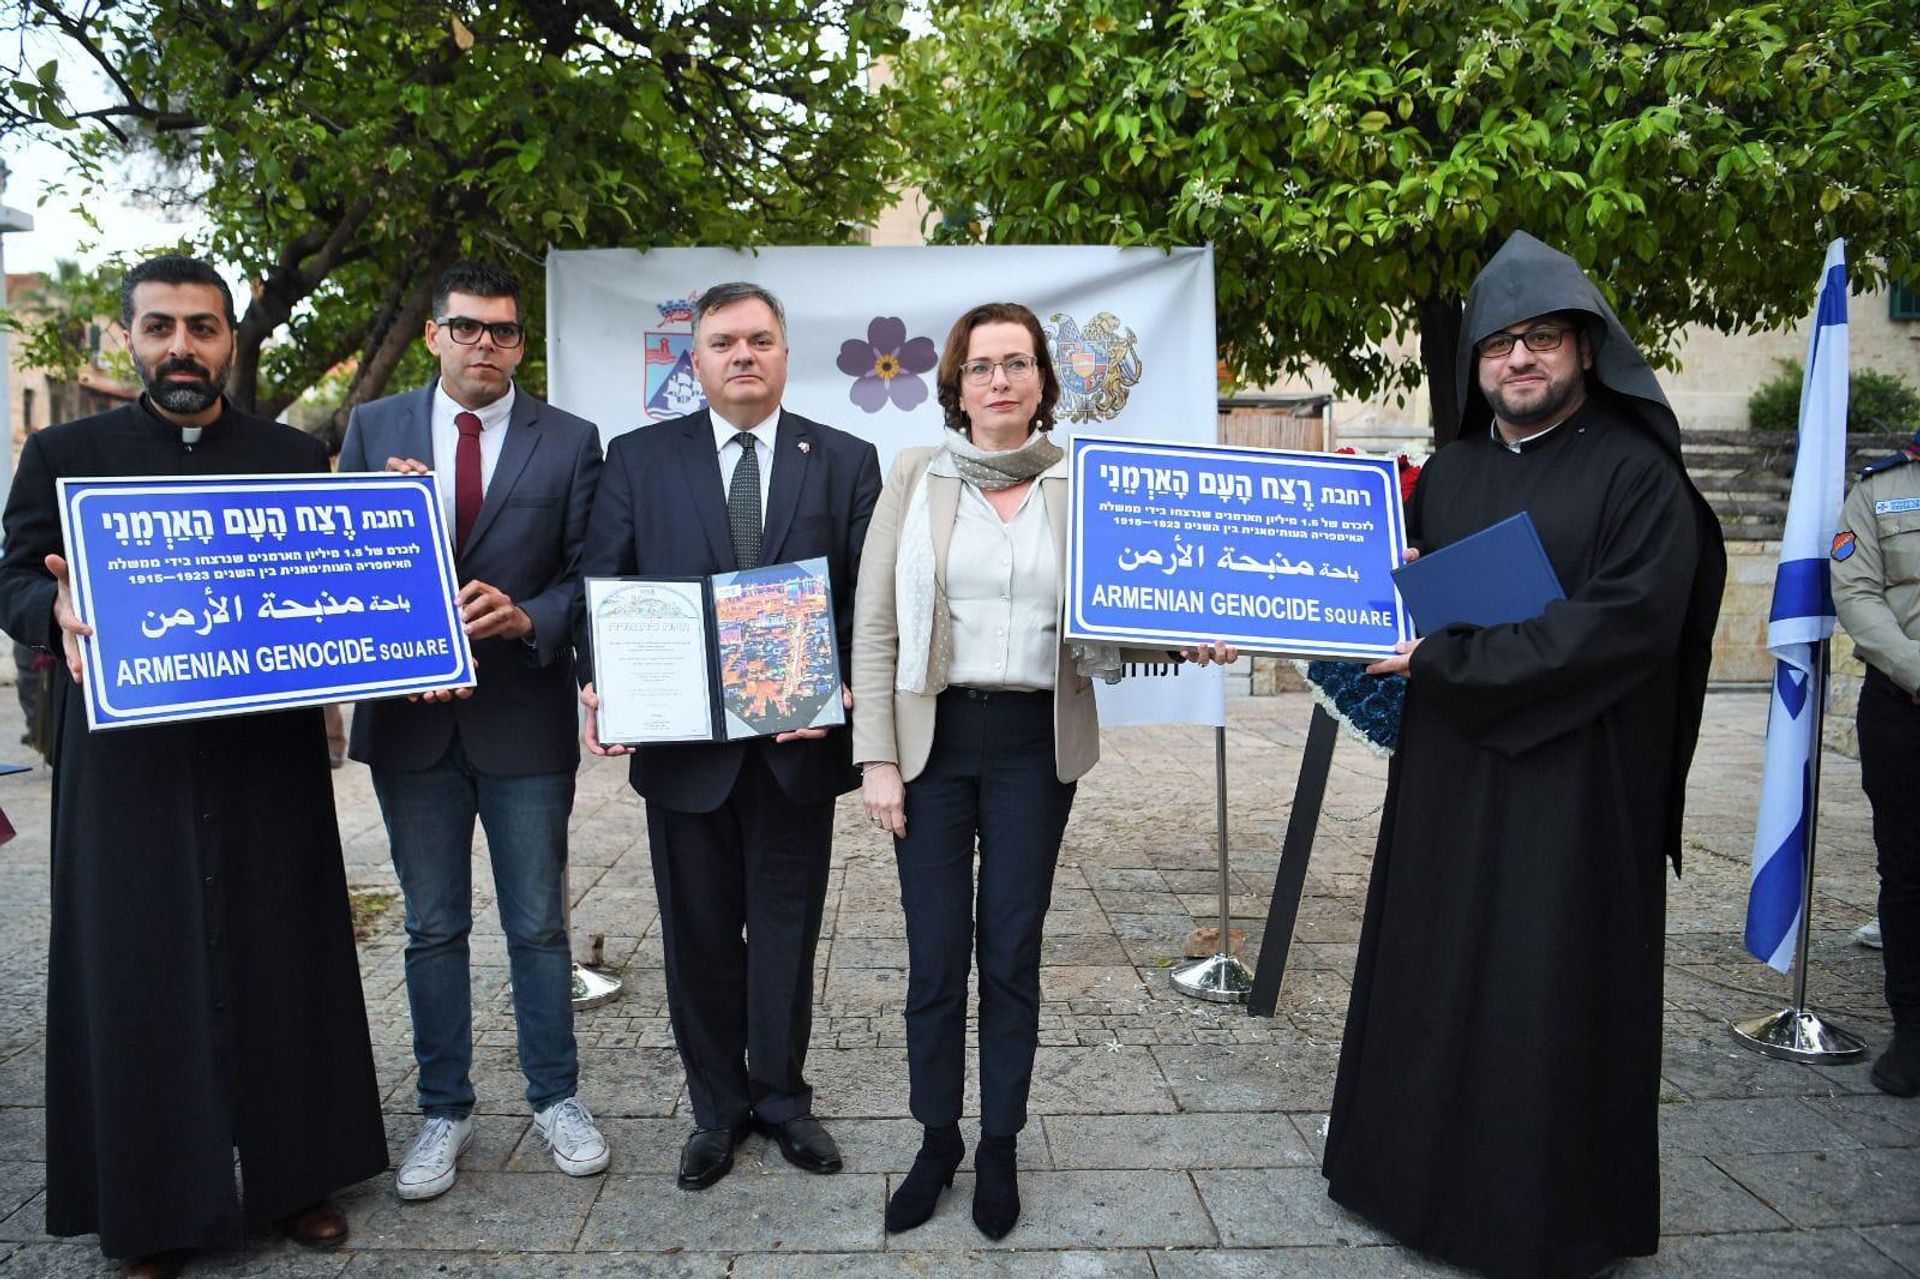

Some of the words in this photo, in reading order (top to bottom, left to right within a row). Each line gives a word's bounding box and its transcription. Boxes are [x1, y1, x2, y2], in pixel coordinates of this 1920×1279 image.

[1321, 488, 1370, 505] רחבת
[362, 510, 414, 529] רחבת
[247, 551, 303, 563] הארמנים
[305, 547, 340, 562] מיליון
[343, 548, 364, 558] 1.5
[364, 545, 384, 556] של
[386, 542, 420, 556] לזכרם
[1119, 535, 1204, 574] الأرمن
[107, 557, 161, 570] ממשלת
[164, 557, 192, 567] בידי
[195, 554, 244, 566] שנרצחו
[1217, 547, 1314, 579] مذبحة
[1319, 563, 1359, 582] باحة
[258, 591, 364, 623] مذبحة
[370, 595, 410, 612] باحة
[1092, 585, 1203, 613] ARMENIAN
[1211, 592, 1320, 621] GENOCIDE
[1325, 608, 1391, 626] SQUARE
[142, 587, 242, 638] الأرمن
[117, 649, 249, 686] ARMENIAN
[256, 638, 376, 672] GENOCIDE
[380, 638, 449, 660] SQUARE
